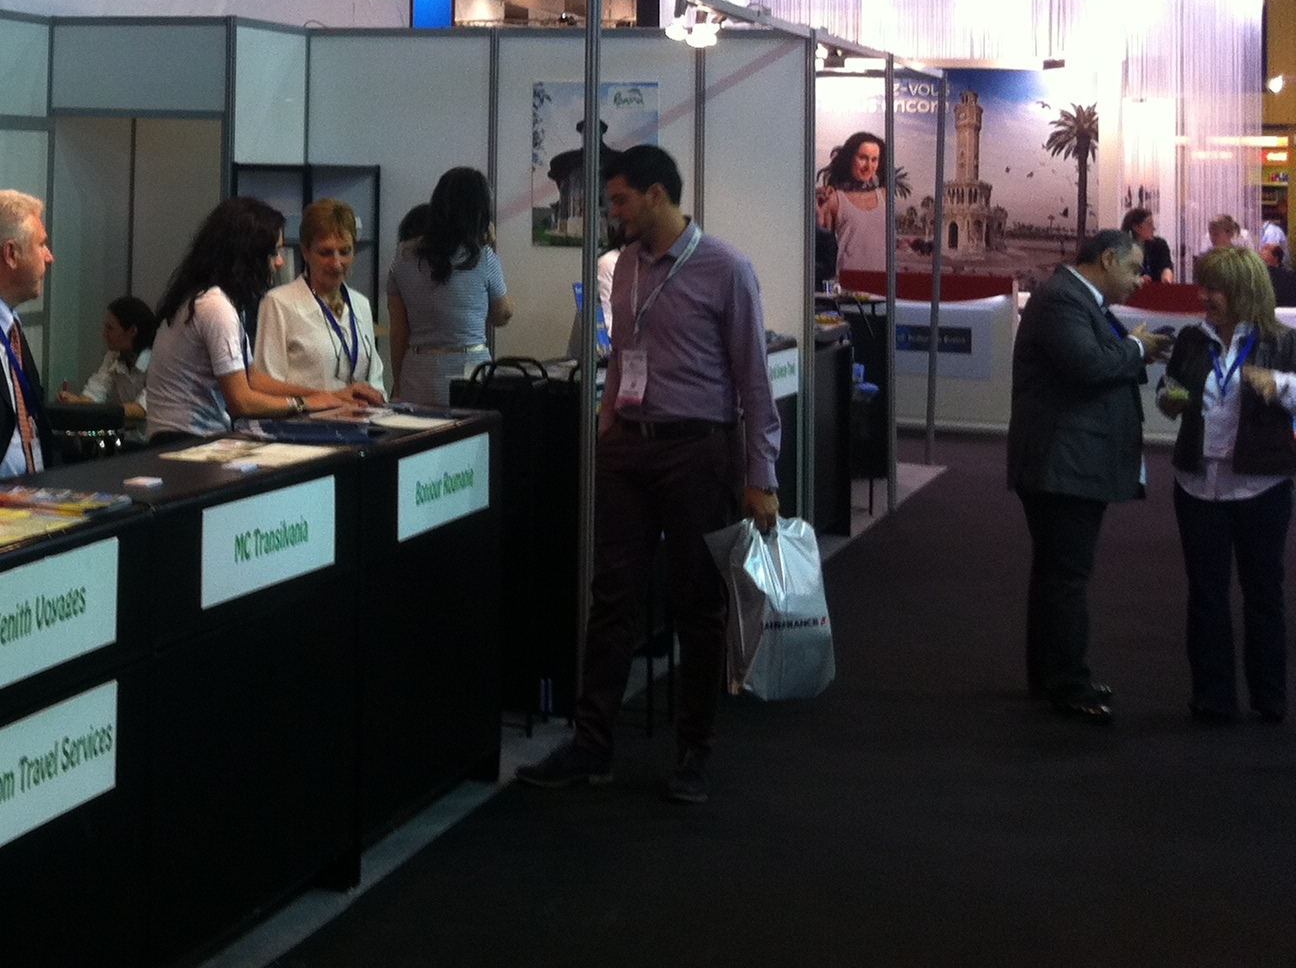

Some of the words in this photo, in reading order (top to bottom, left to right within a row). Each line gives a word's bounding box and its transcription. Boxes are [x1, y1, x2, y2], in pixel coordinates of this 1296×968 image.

[234, 530, 252, 565] MC
[18, 740, 58, 793] Travel
[61, 724, 113, 773] Services
